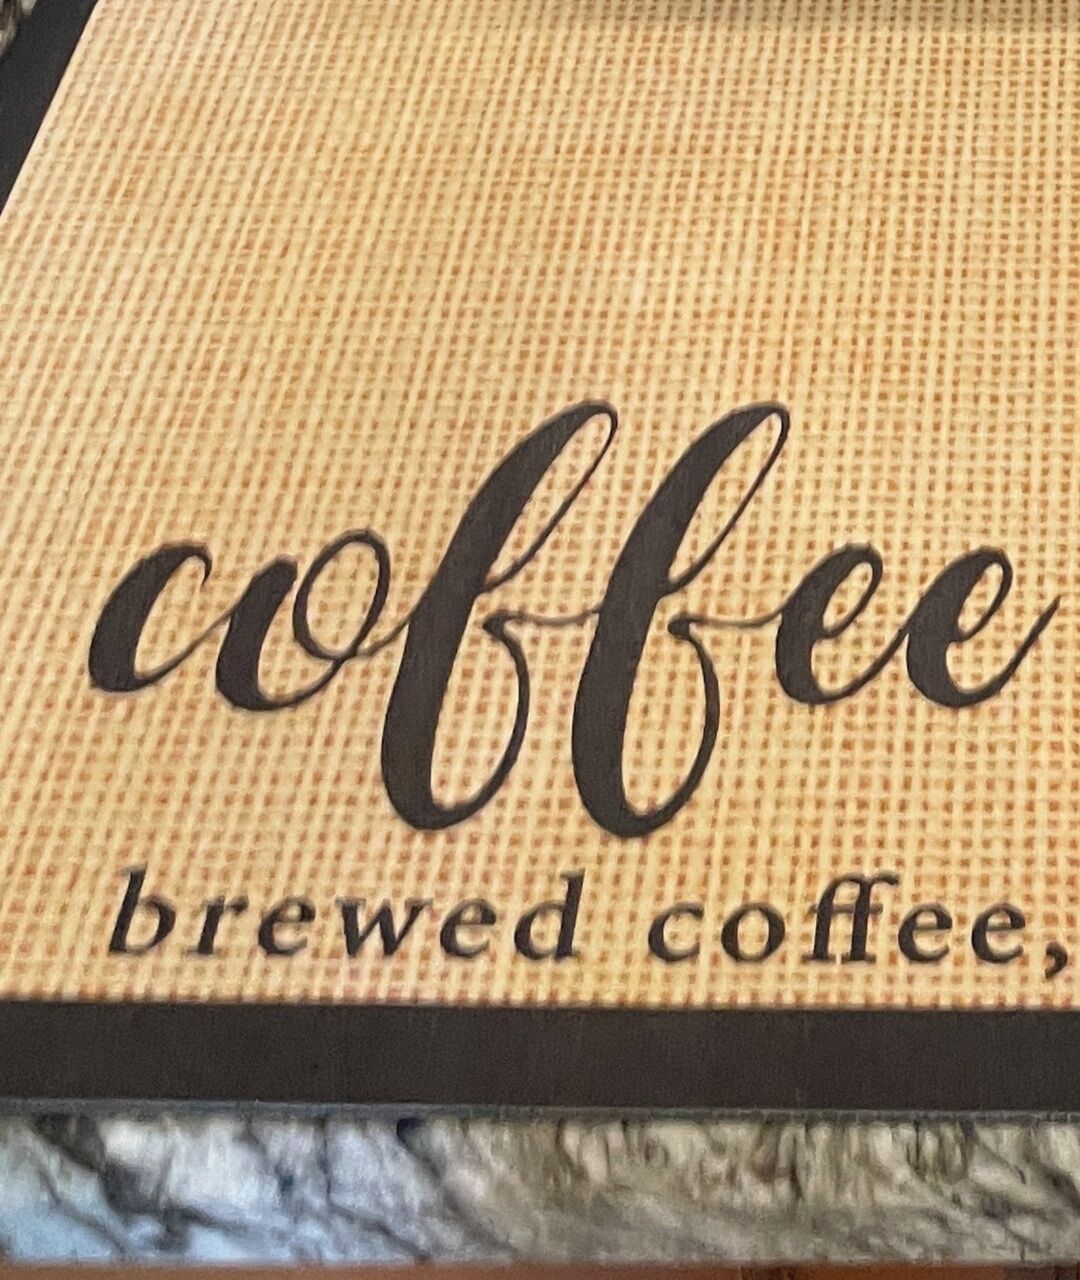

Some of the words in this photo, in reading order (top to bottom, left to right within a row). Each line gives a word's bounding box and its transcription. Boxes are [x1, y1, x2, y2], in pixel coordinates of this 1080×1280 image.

[88, 400, 1060, 837] coffee
[107, 869, 584, 960] brewed
[647, 871, 1068, 978] coffee,
